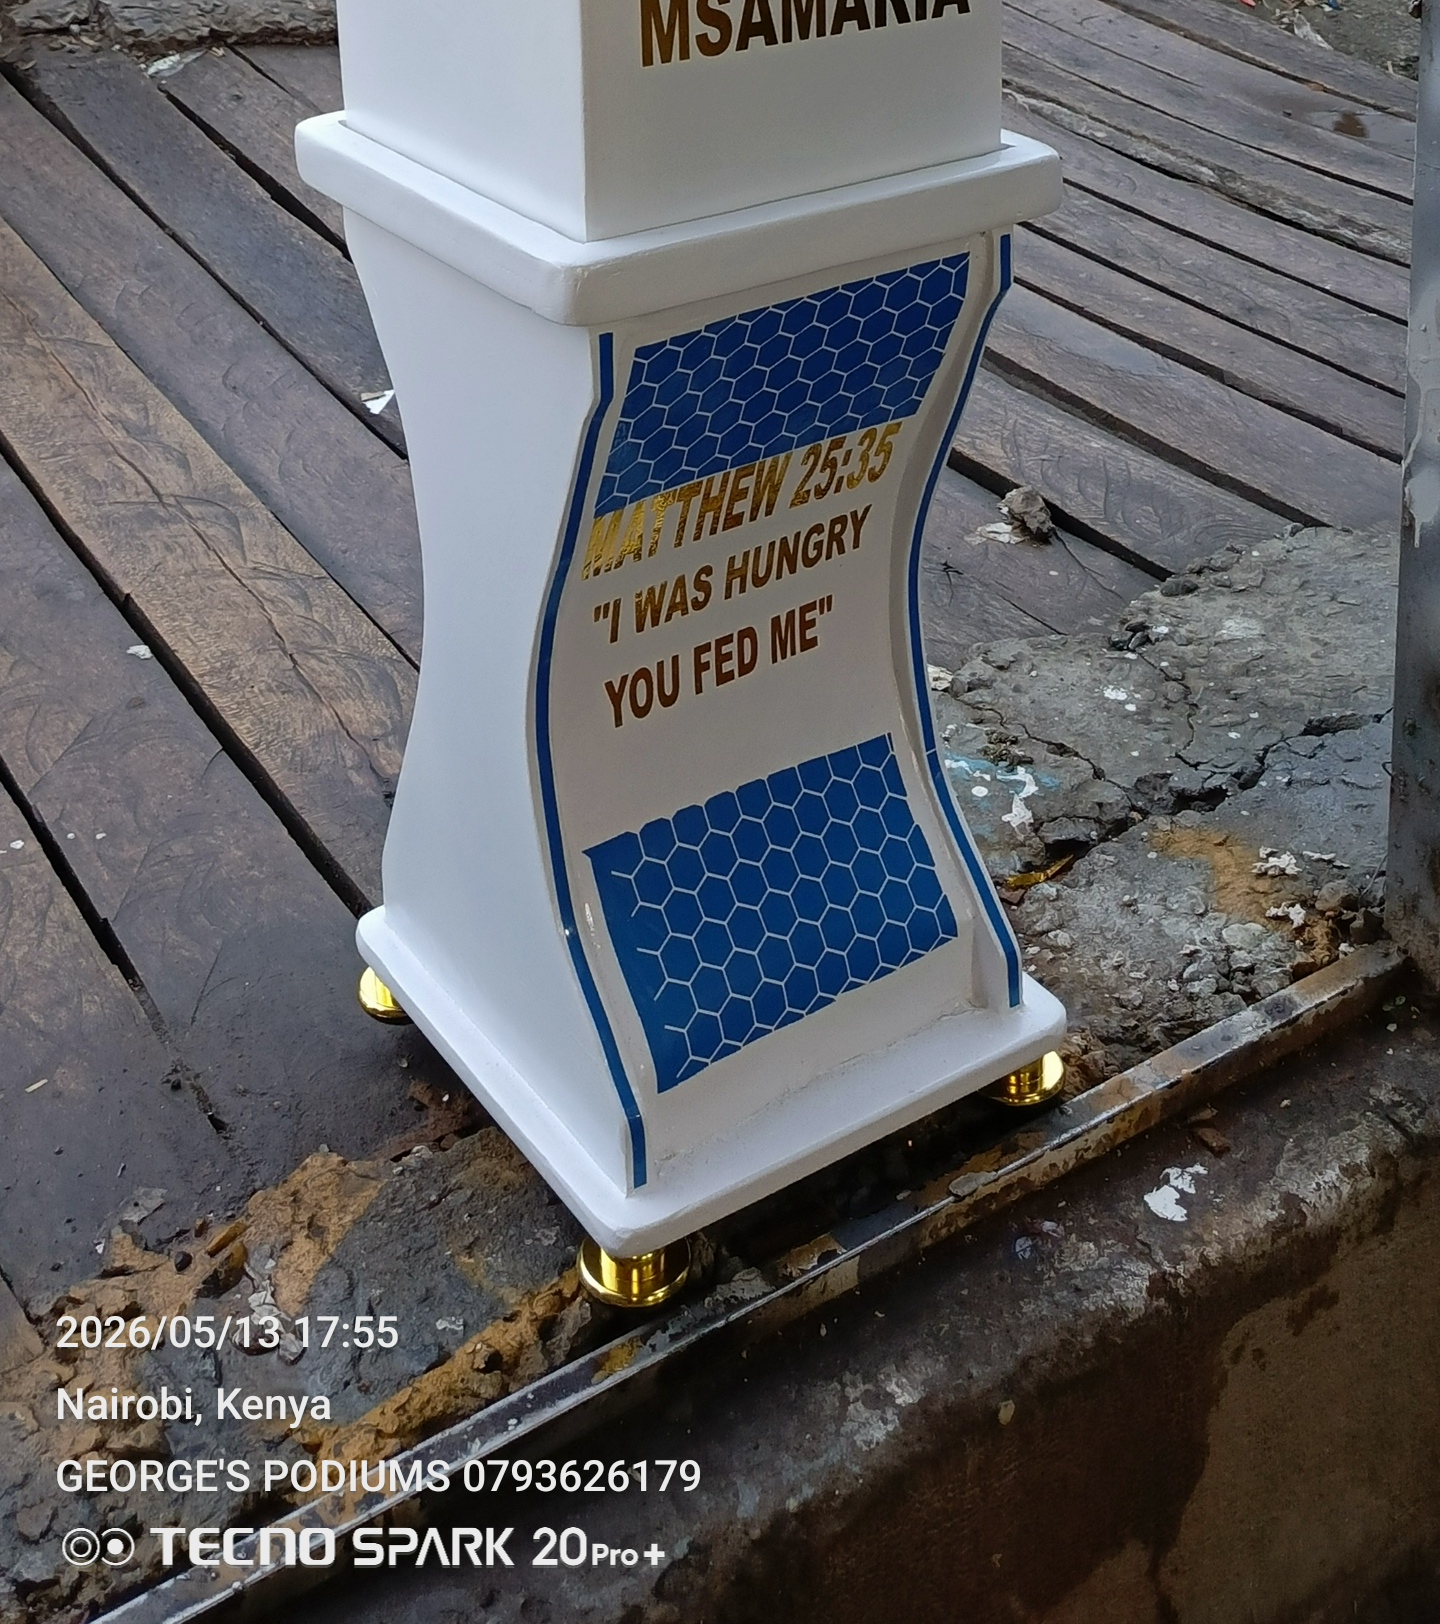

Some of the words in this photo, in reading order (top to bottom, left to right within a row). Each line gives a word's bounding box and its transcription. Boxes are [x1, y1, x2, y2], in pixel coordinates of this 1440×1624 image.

[582, 452, 794, 580] MATTHEW
[789, 422, 902, 511] 25:35
[593, 598, 622, 644] "I
[635, 569, 713, 634] WAS
[724, 504, 872, 600] HUNGRY
[604, 655, 680, 728] YOU
[693, 626, 758, 695] FED
[771, 595, 833, 665] ME"
